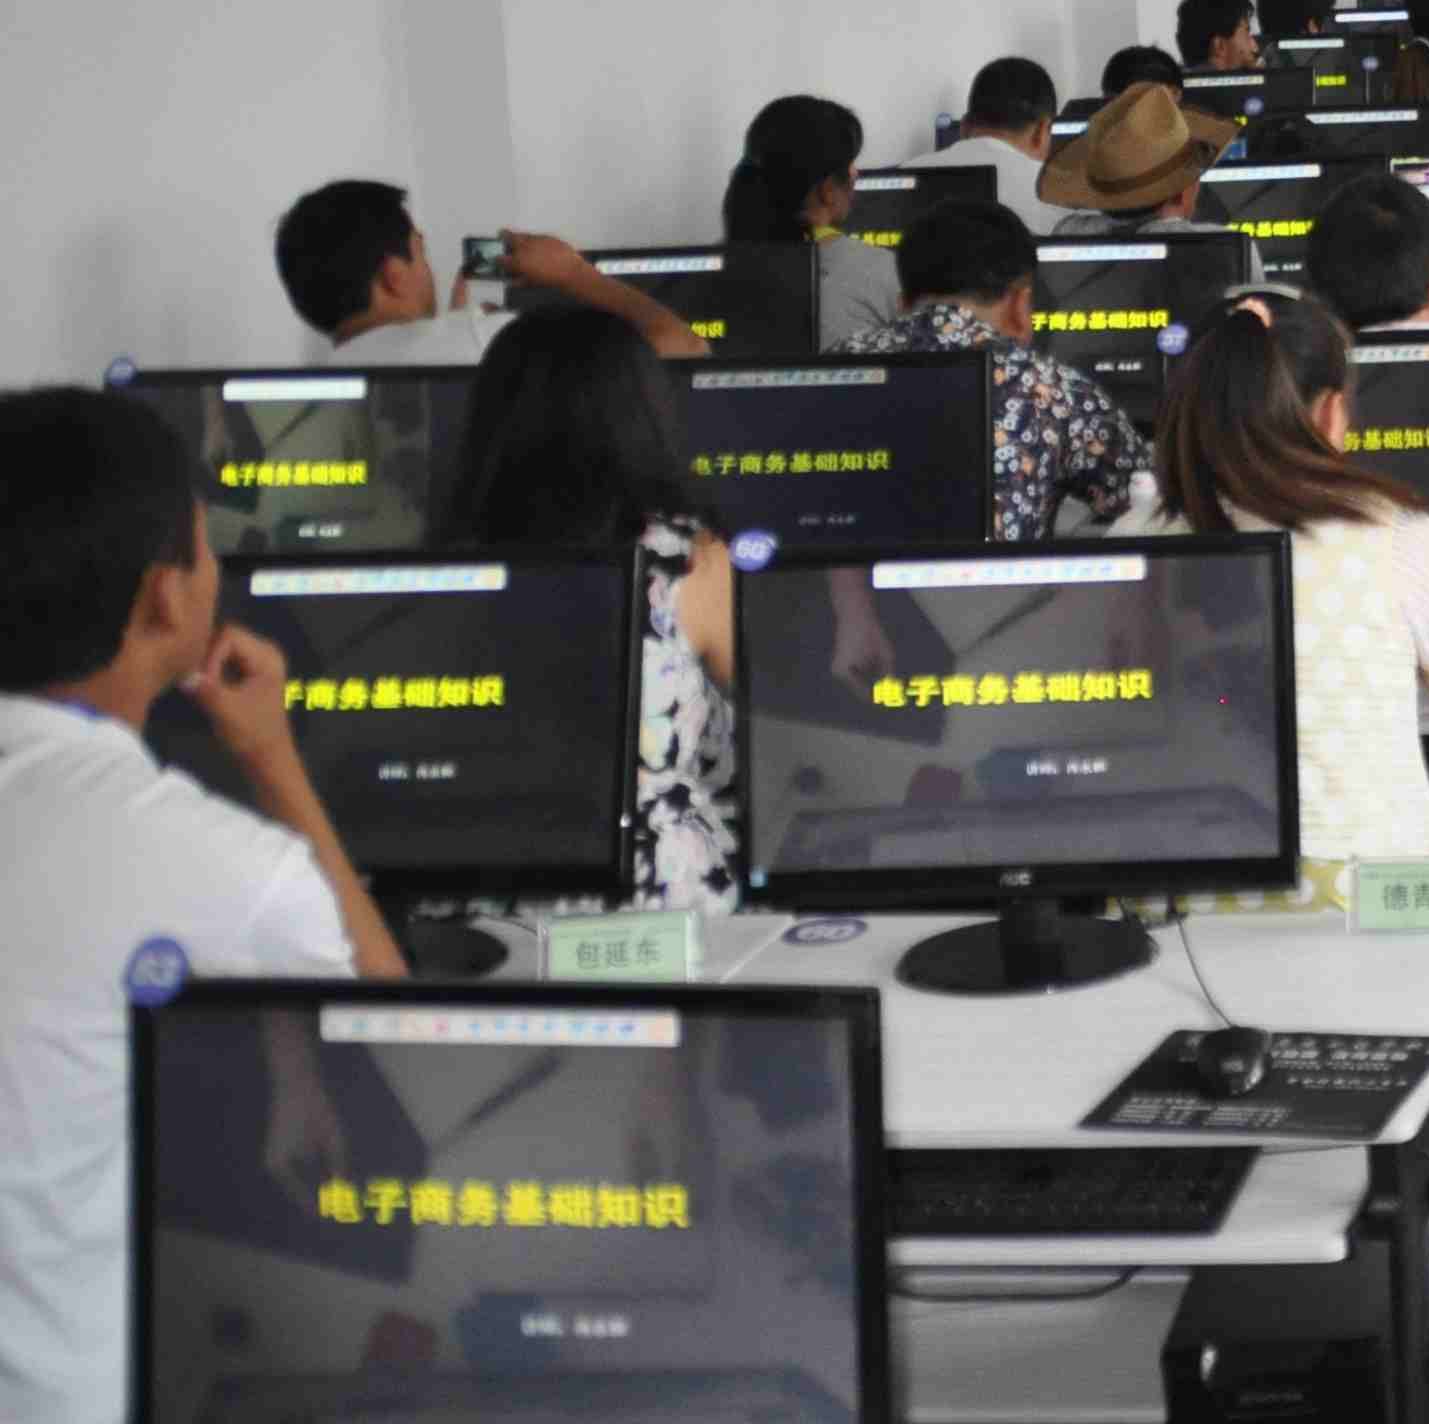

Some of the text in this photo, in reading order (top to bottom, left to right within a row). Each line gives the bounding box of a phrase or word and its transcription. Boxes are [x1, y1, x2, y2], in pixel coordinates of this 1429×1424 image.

[219, 460, 368, 489] 电子商务基础知识
[871, 667, 1153, 709] 电子商务基础知识
[319, 1178, 690, 1228] 电子商务基础知识
